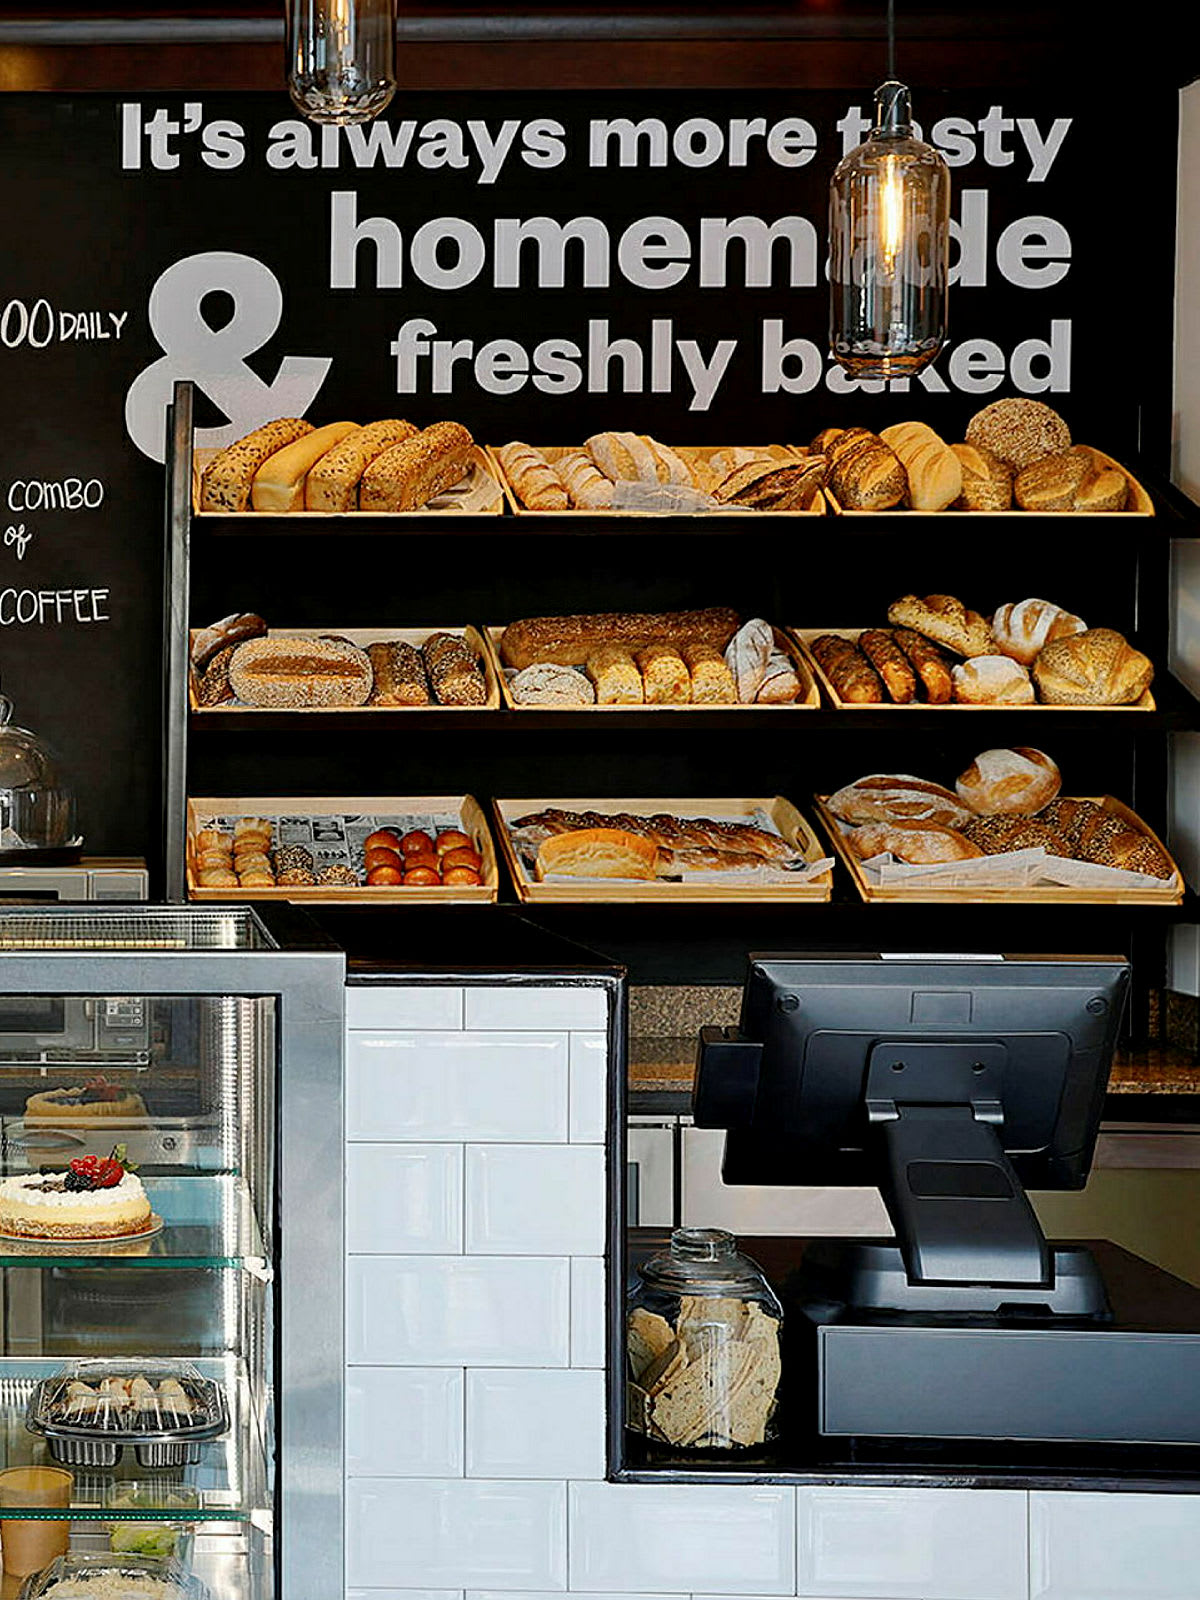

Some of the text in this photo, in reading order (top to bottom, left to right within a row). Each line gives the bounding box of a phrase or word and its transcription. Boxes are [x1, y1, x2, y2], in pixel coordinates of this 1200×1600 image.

[123, 103, 1072, 184] It's always more tsty
[330, 191, 1072, 290] homemde
[60, 312, 127, 341] DAILY
[391, 319, 737, 411] freshly
[4, 524, 32, 560] of
